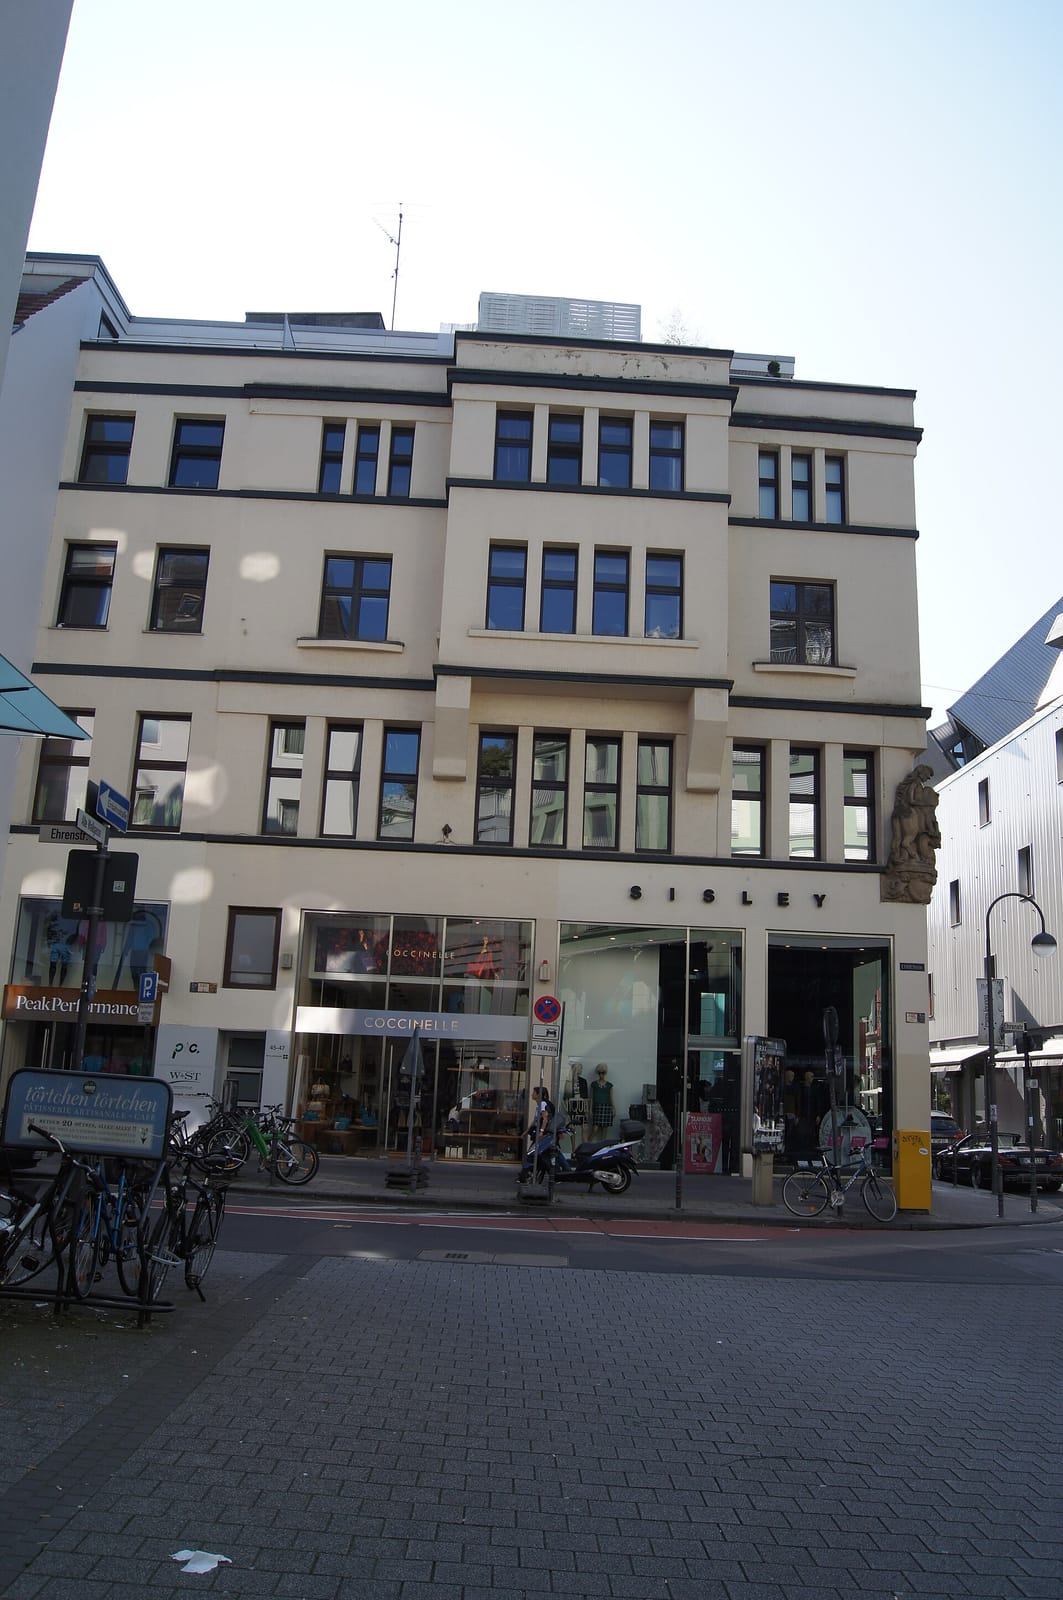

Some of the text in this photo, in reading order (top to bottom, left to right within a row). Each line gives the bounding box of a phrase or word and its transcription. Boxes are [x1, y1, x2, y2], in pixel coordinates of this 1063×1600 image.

[50, 828, 89, 841] Ehrenstr.
[630, 885, 827, 908] SISLEY
[16, 995, 141, 1016] PeakPerfrmanc
[364, 1017, 459, 1032] COCCINELLE
[25, 1081, 158, 1113] törtchen törtchen
[62, 1119, 73, 1127] 20
